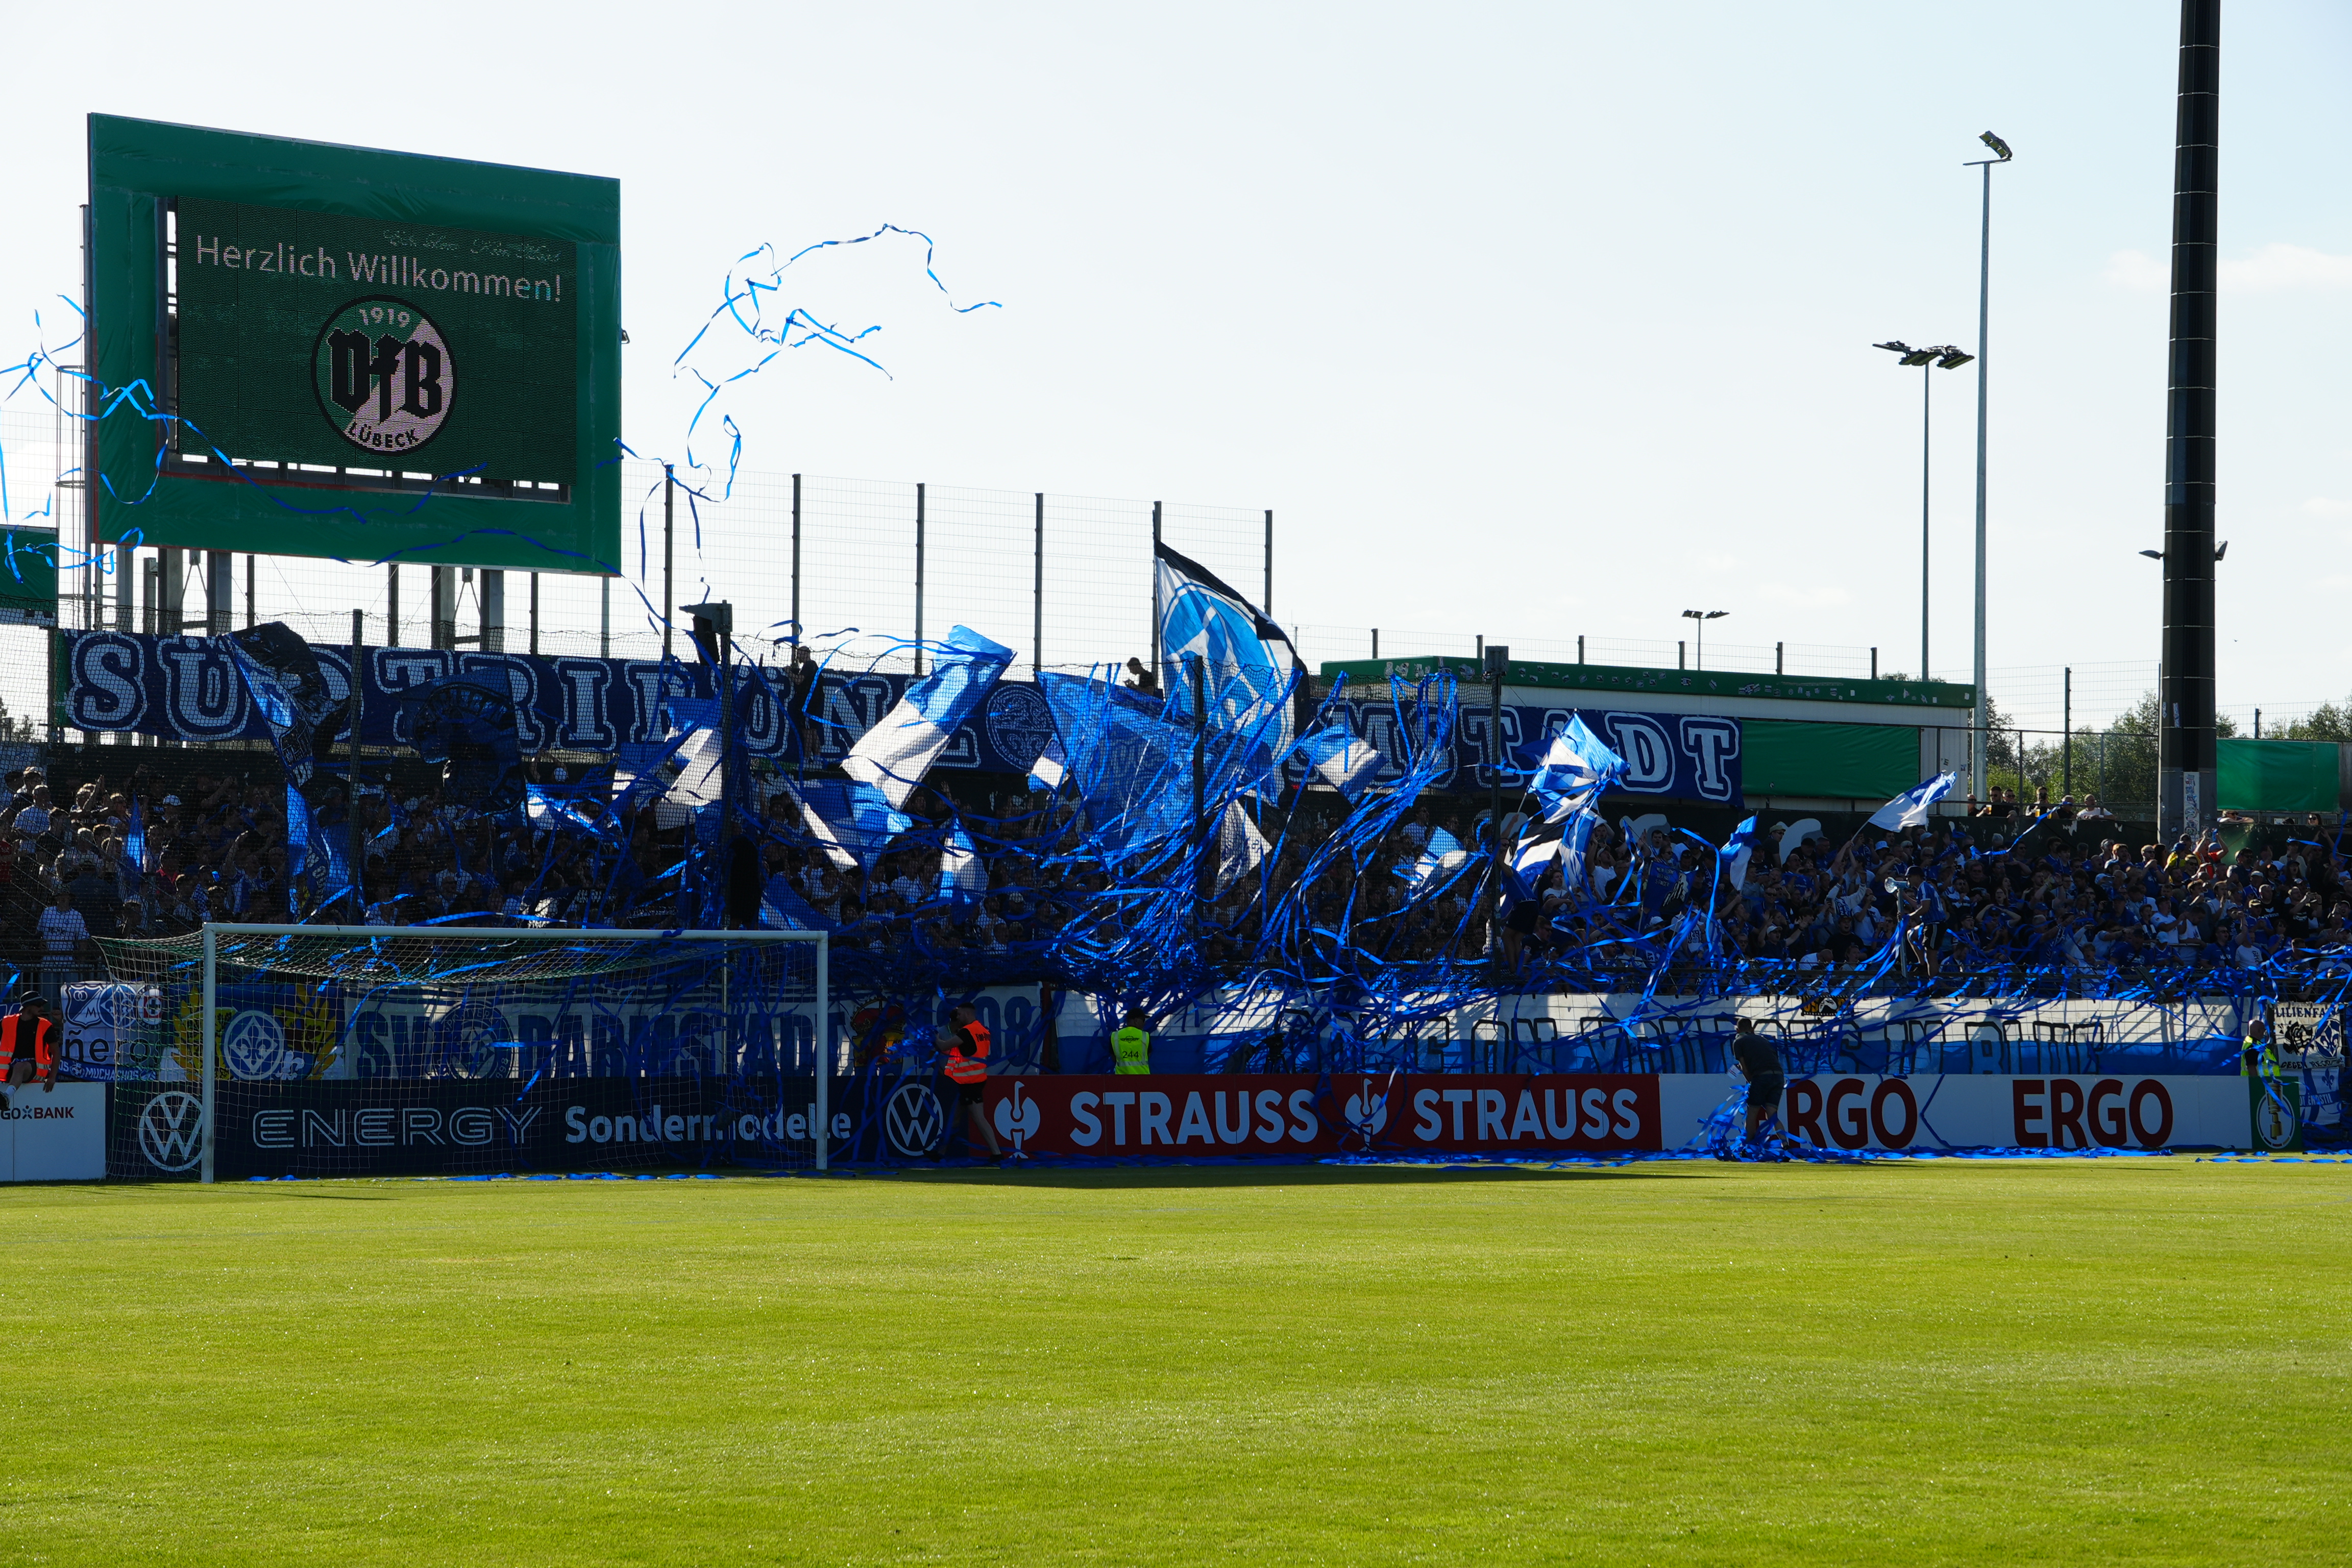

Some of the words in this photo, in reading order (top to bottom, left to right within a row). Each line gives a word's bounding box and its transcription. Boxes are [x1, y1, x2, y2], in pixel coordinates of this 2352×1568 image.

[197, 234, 336, 278] Herzlich
[347, 250, 561, 302] Willkommen!
[358, 306, 410, 328] 1919
[348, 422, 418, 449] LÜBECK
[2275, 1007, 2336, 1018] LILIENFA
[1122, 1050, 1139, 1059] 244
[253, 1106, 543, 1148] ENERGY
[565, 1102, 851, 1143] Sondermodele
[1070, 1089, 1319, 1147] STRAUSS
[1413, 1087, 1640, 1141] STRAUSS
[1759, 1078, 1918, 1149] RGO
[2012, 1078, 2174, 1148] ERGO
